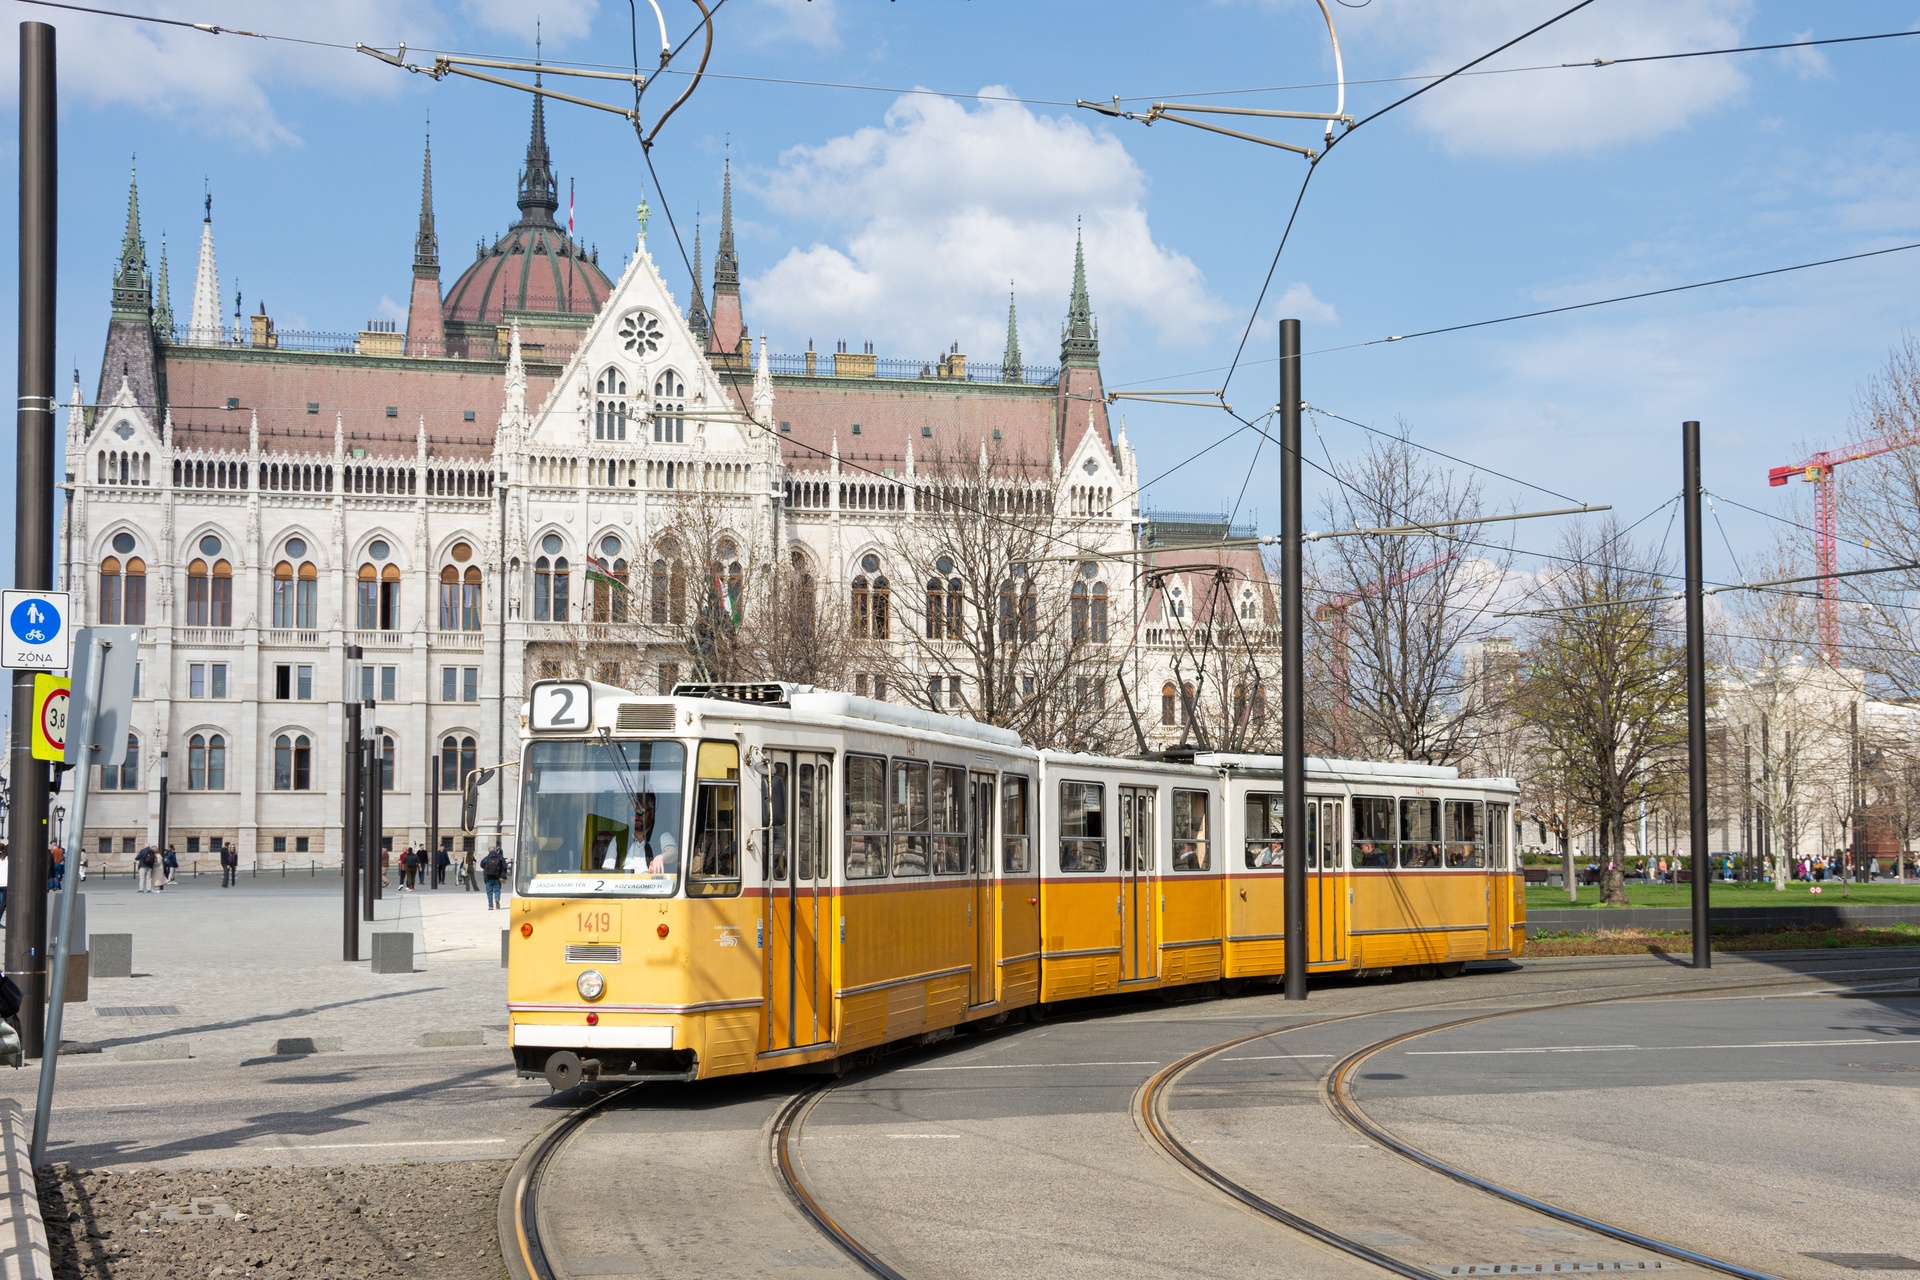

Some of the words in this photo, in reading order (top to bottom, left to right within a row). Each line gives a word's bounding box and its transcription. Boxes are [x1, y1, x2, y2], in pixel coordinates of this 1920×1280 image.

[17, 651, 53, 663] ZÓNA
[549, 687, 576, 726] 2
[49, 708, 66, 730] 3,8
[1272, 798, 1279, 811] 2
[594, 880, 605, 892] 2
[577, 911, 611, 933] 1419
